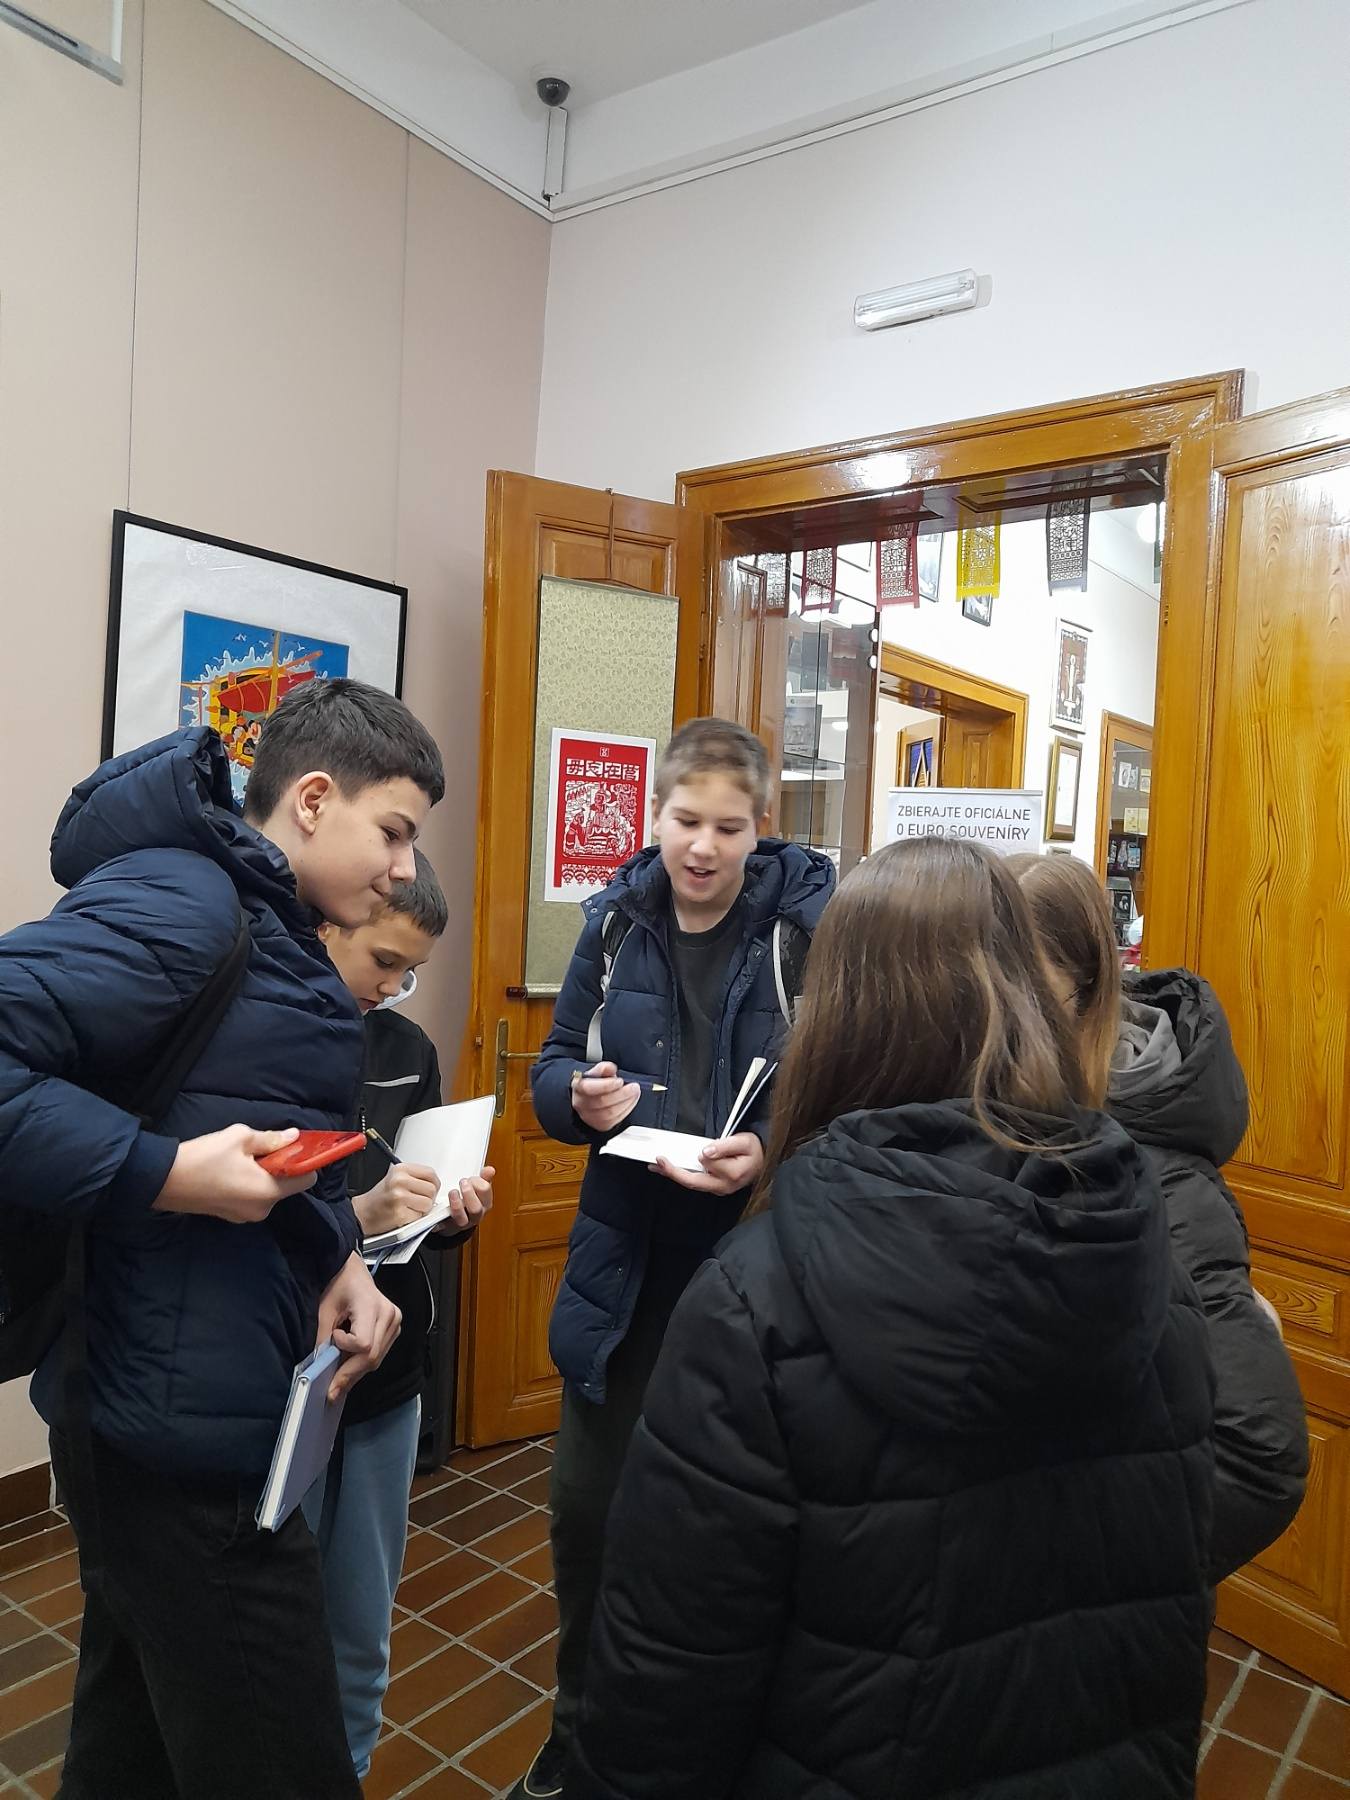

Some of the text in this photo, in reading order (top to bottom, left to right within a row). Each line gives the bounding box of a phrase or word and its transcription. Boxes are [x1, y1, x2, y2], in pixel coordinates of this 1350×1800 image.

[897, 805, 1031, 821] ZBIERAJTE OFICIÁLNE
[907, 823, 945, 837] EURO
[949, 824, 1031, 841] SOUVENÍRY
